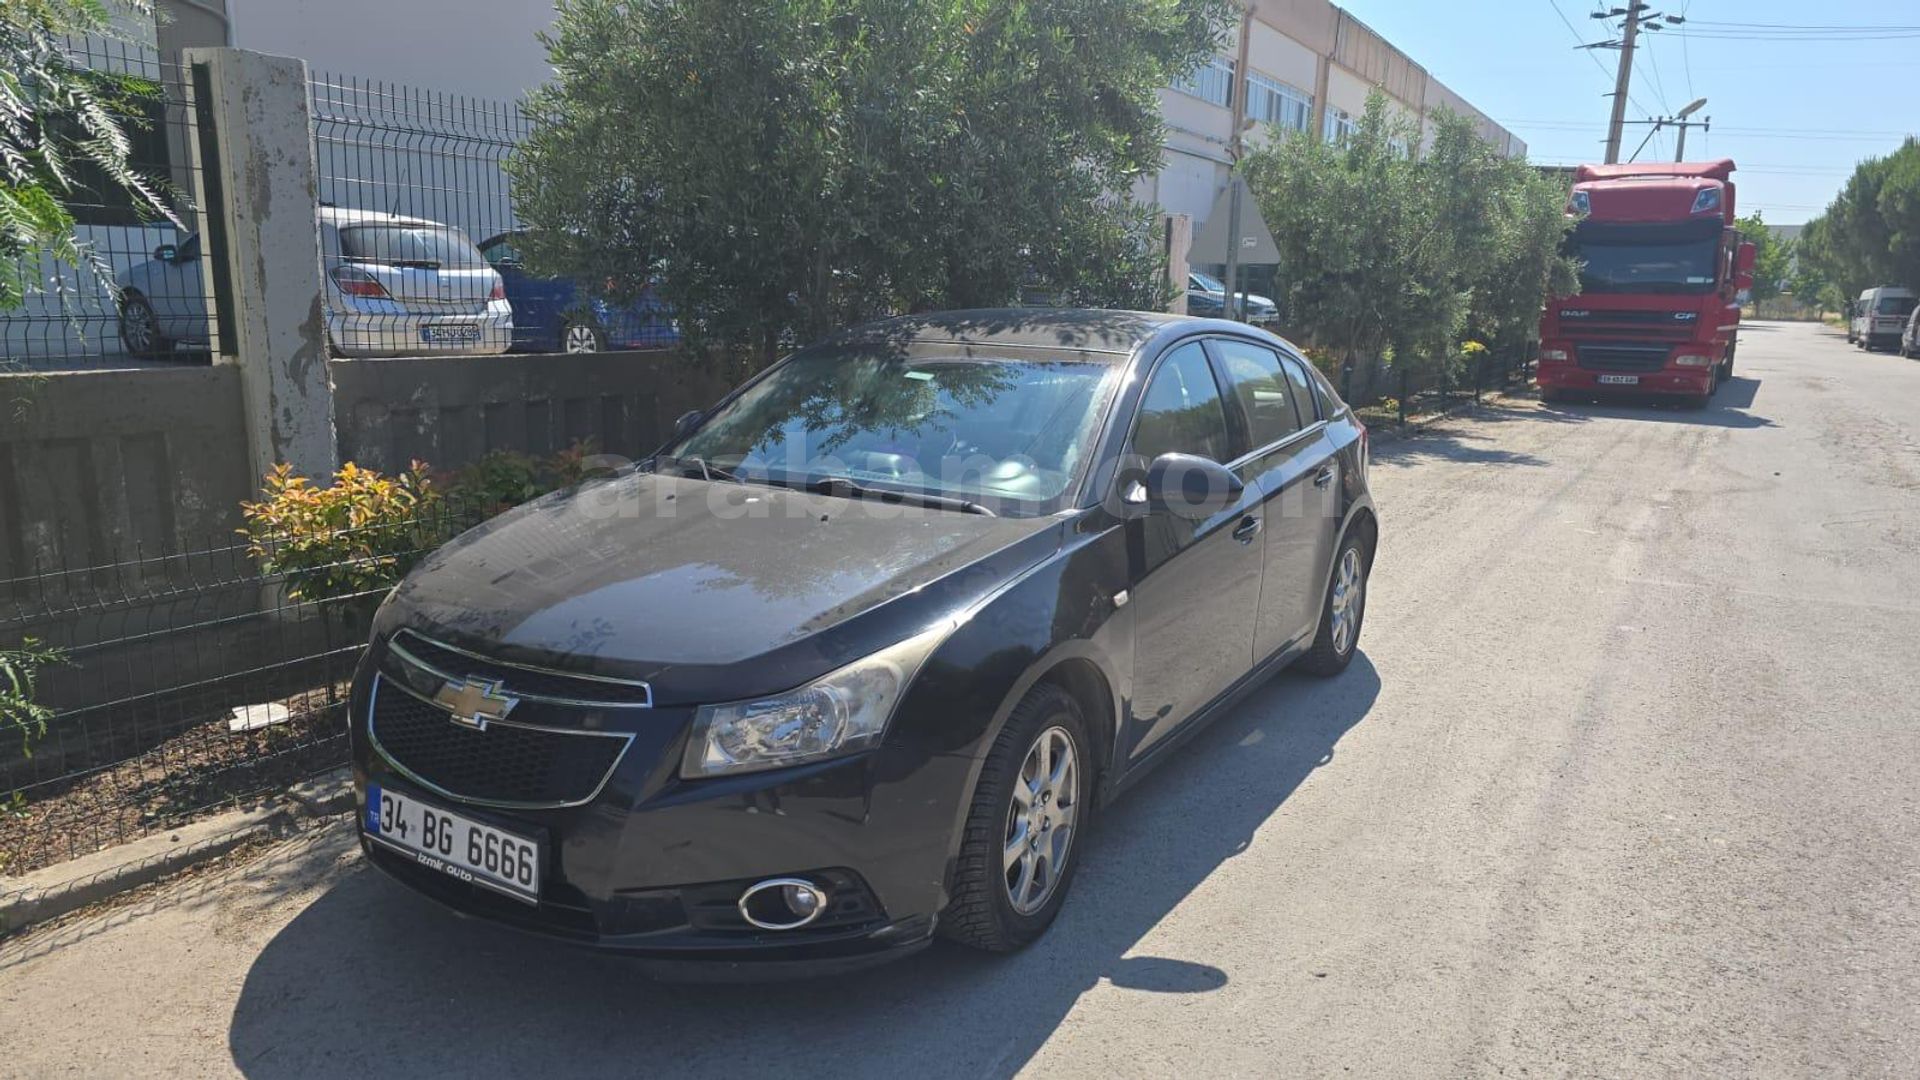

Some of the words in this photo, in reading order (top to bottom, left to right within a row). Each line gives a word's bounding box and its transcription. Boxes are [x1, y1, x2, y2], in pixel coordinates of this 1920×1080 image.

[1674, 312, 1697, 320] CF
[382, 795, 407, 839] 34
[422, 810, 453, 855] BG
[467, 827, 533, 885] 6666
[446, 865, 472, 882] auto
